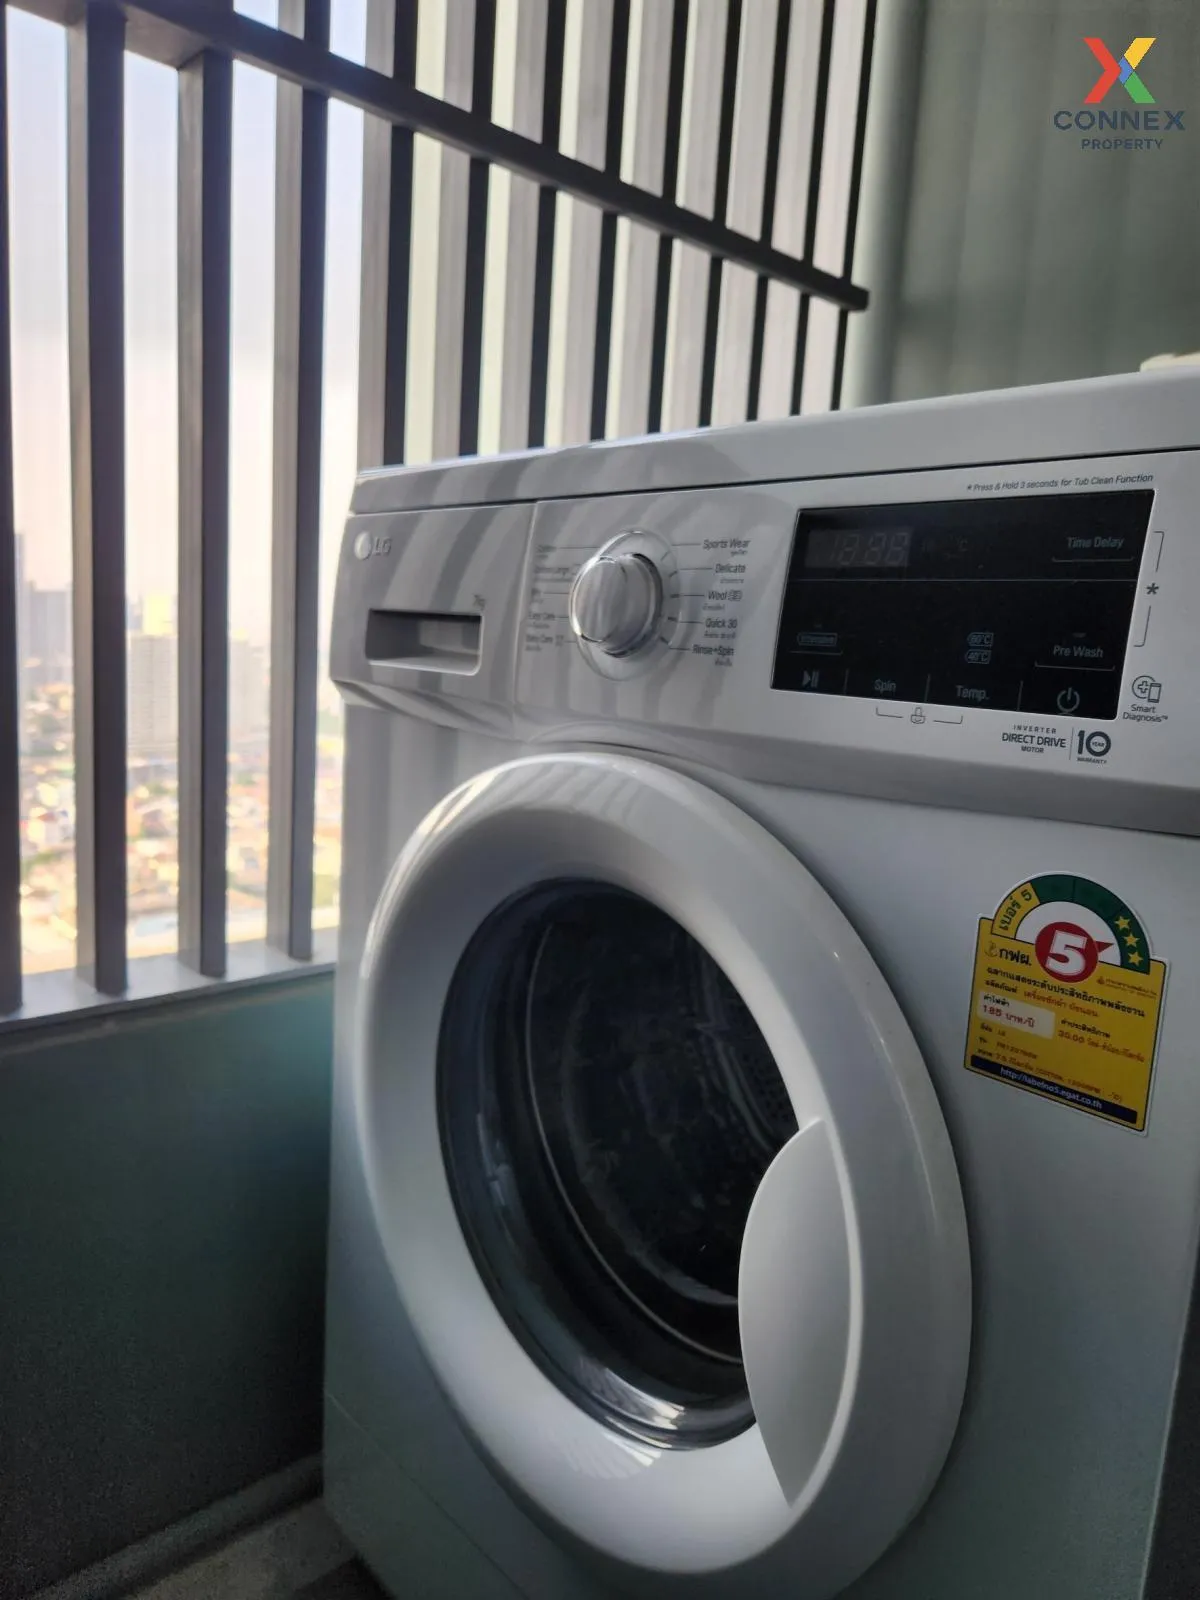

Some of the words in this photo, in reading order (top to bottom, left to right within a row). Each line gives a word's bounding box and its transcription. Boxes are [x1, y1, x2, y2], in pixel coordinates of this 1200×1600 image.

[973, 483, 993, 492] Press
[1001, 481, 1018, 490] Hold
[1019, 481, 1025, 489] 3
[1026, 479, 1058, 488] seconds
[1060, 478, 1071, 487] for
[1074, 477, 1089, 486] Tub
[1091, 476, 1114, 485] Clean
[1115, 474, 1154, 484] Function
[371, 536, 393, 557] LG
[703, 539, 727, 550] Sports
[729, 538, 751, 549] Wear
[1067, 536, 1092, 548] Time
[1094, 536, 1124, 549] Delay
[715, 563, 746, 574] Delicate
[708, 590, 727, 601] Wool
[705, 618, 726, 629] Quick
[727, 618, 738, 629] 30
[1053, 645, 1071, 657] Pre
[1072, 645, 1104, 658] Wash
[874, 679, 896, 693] Spin
[956, 685, 990, 701] Temp.
[1131, 703, 1156, 713] Smart
[1013, 724, 1056, 735] INVERTER
[1001, 732, 1036, 745] DIRECT
[1037, 735, 1067, 748] DRIVE
[1077, 730, 1111, 757] 10
[1021, 745, 1045, 754] MOTOR
[999, 895, 1021, 931] เบอร์
[1020, 889, 1032, 902] 5
[1045, 929, 1088, 976] 5
